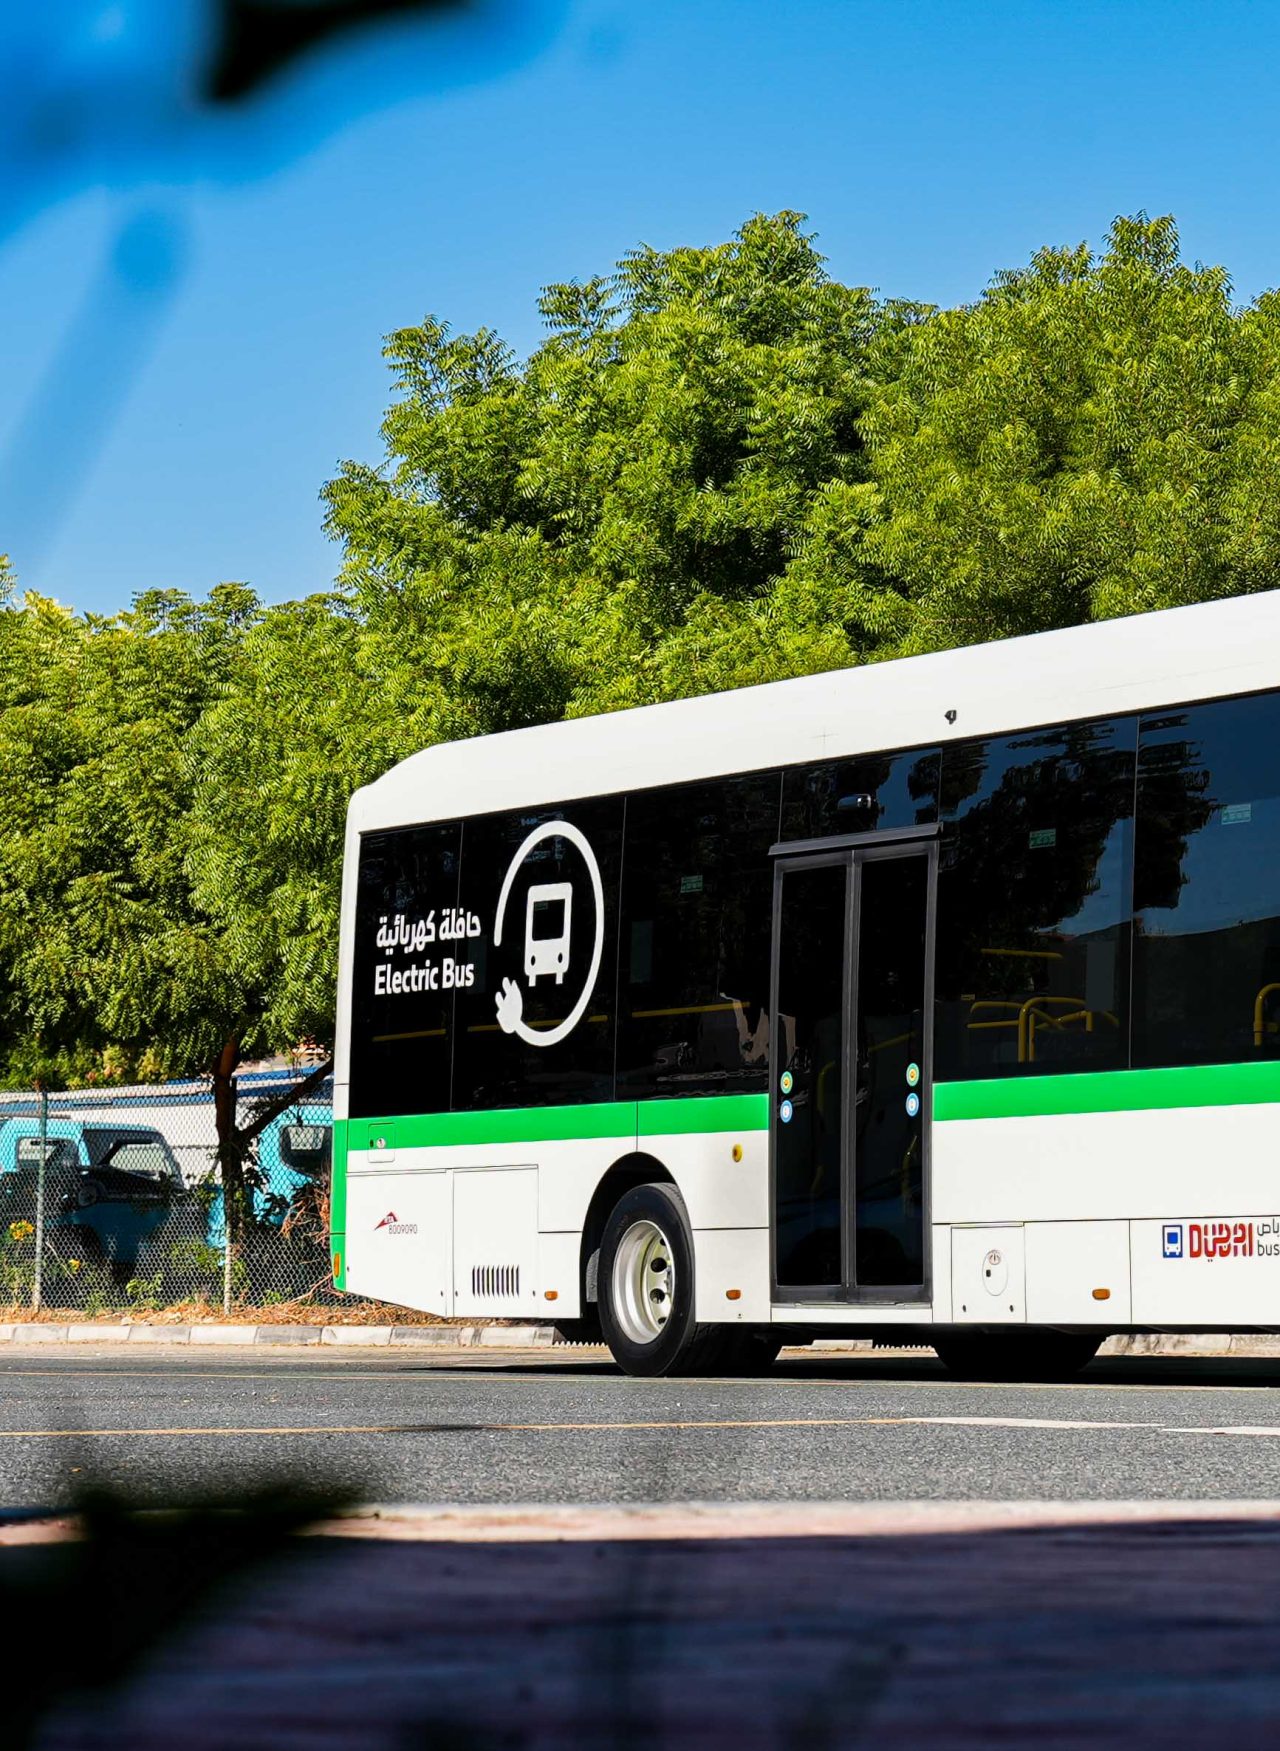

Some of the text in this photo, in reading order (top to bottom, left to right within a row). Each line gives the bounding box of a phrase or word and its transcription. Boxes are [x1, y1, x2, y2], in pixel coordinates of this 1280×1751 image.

[376, 907, 481, 956] حافلة كهربائية
[374, 957, 475, 995] Electric Bus
[1188, 1222, 1253, 1263] DUBAI
[1256, 1218, 1280, 1238] باص
[1257, 1239, 1280, 1257] bus
